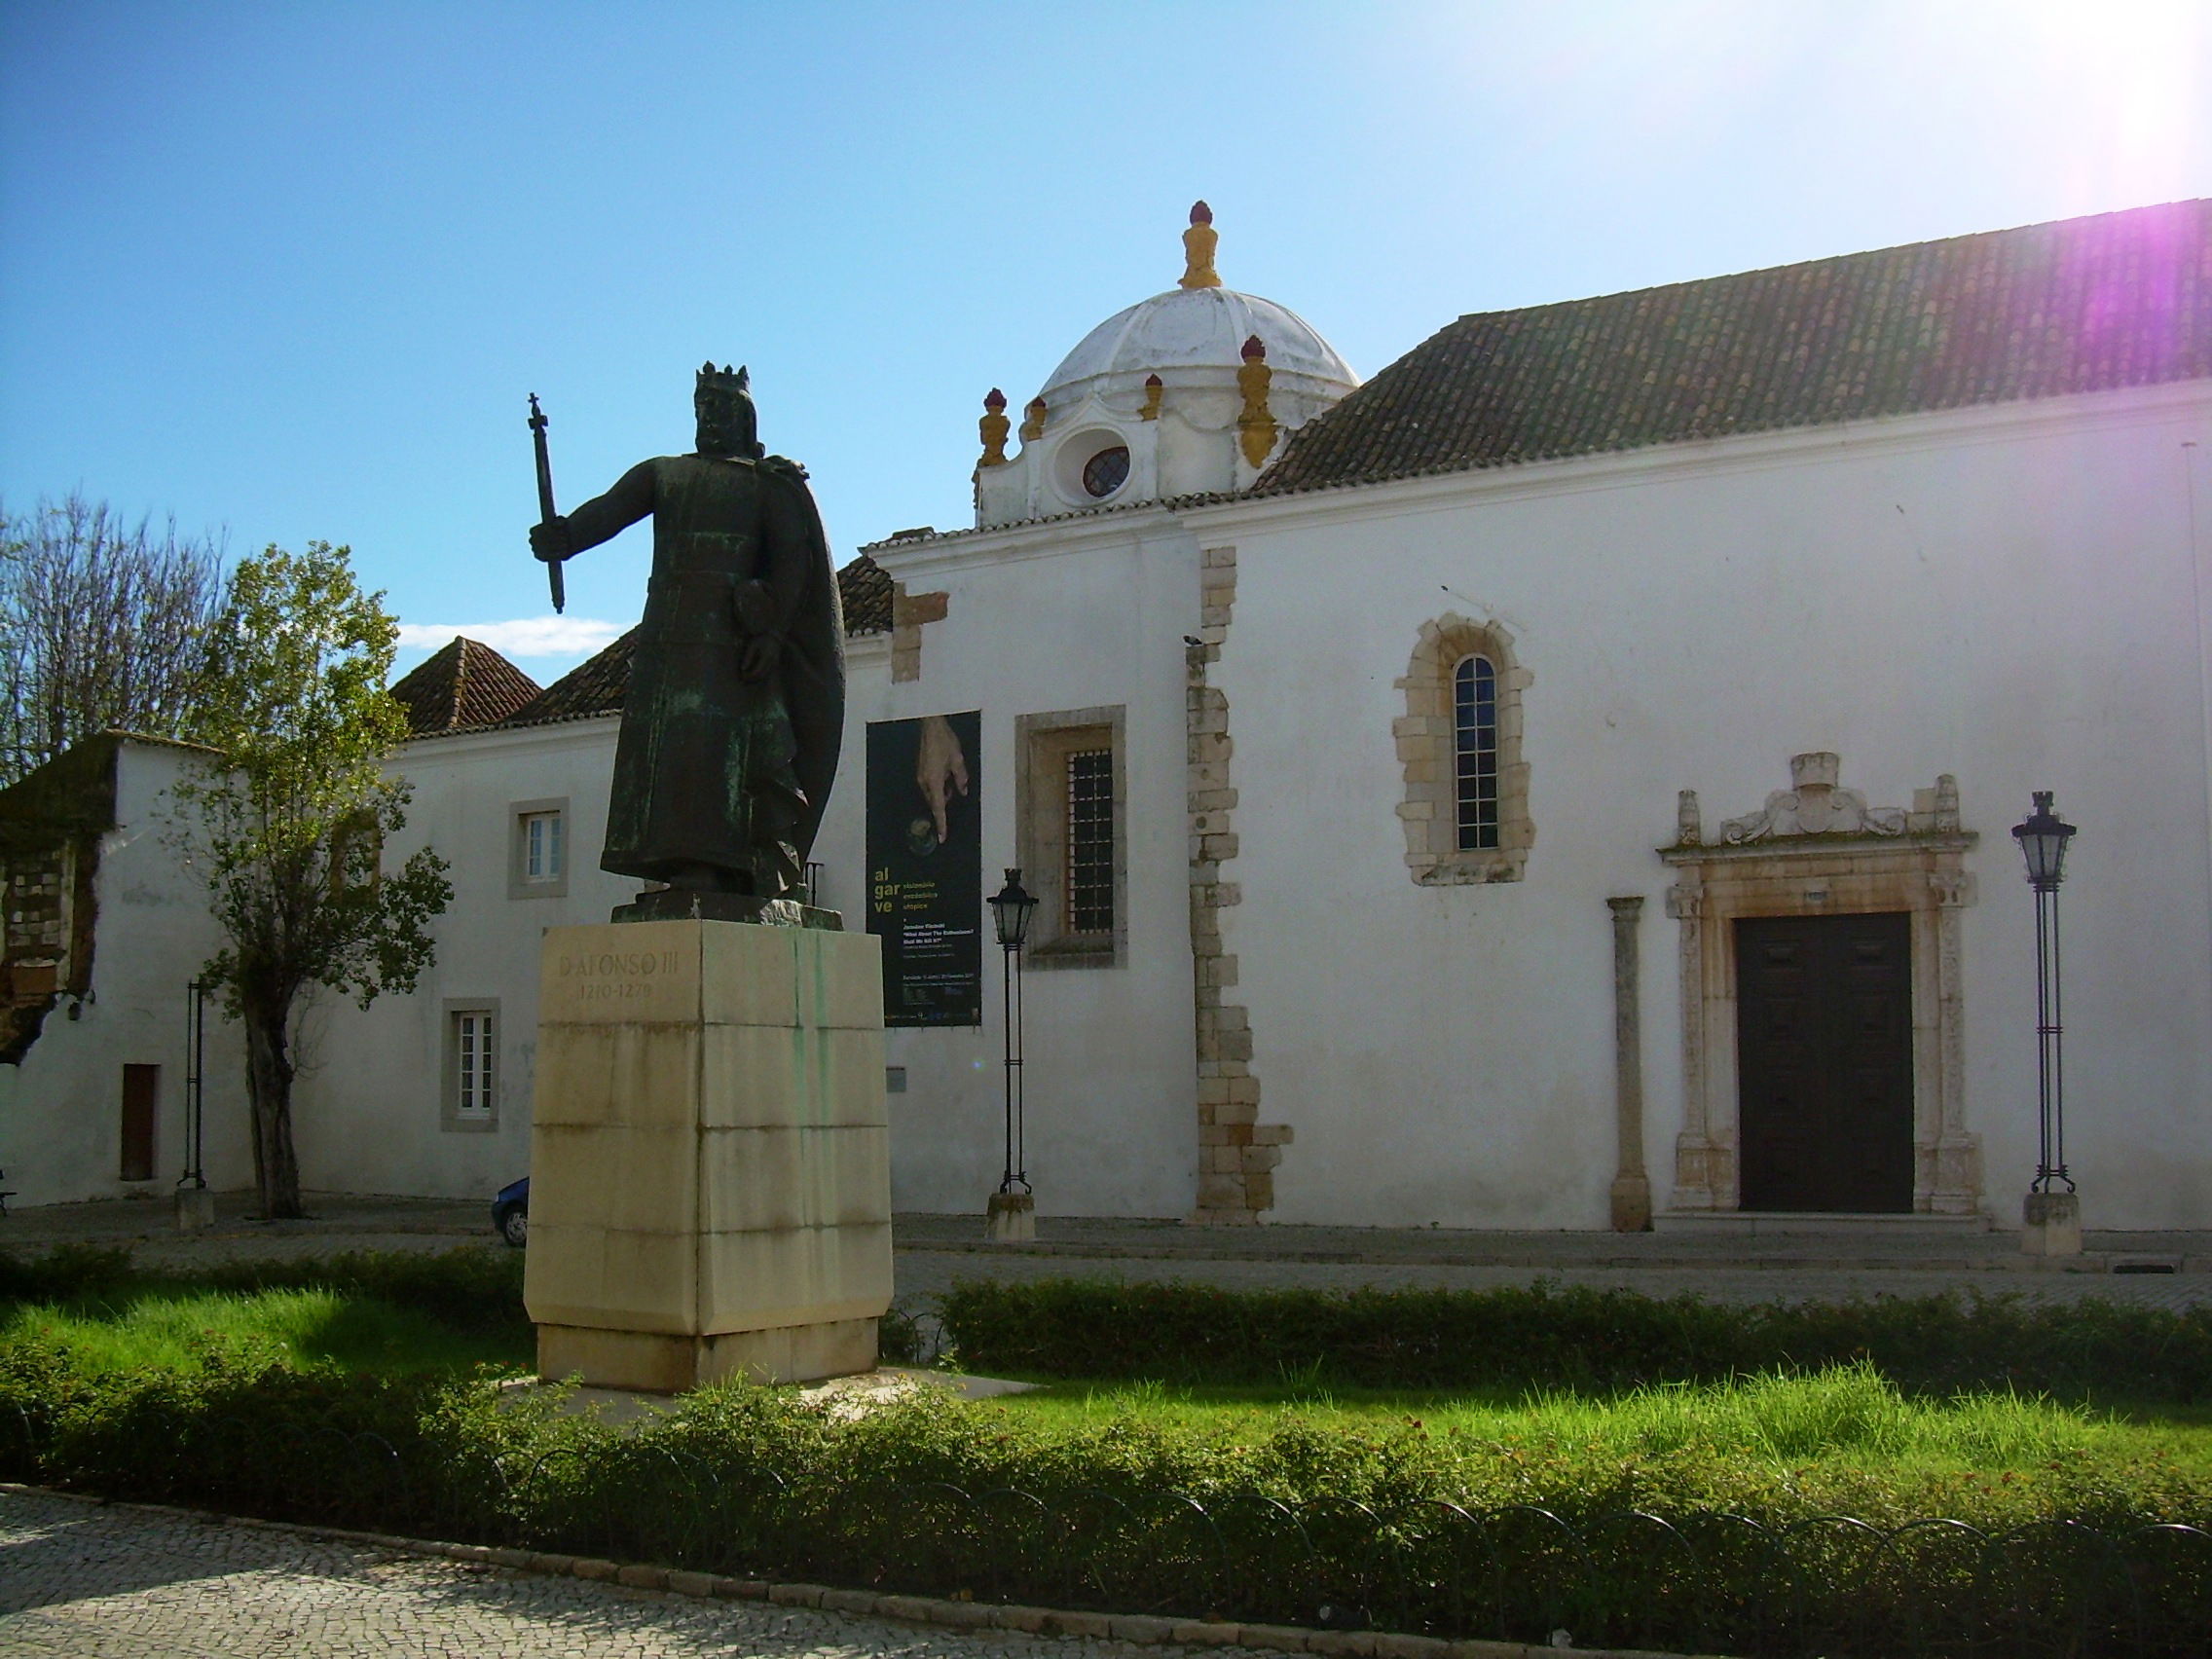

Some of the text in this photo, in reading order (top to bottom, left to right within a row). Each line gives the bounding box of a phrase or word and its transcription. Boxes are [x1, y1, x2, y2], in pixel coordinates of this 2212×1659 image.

[874, 867, 889, 881] al
[874, 884, 901, 901] gar
[874, 902, 893, 913] ve
[575, 953, 657, 976] AFONSO
[662, 951, 679, 974] III
